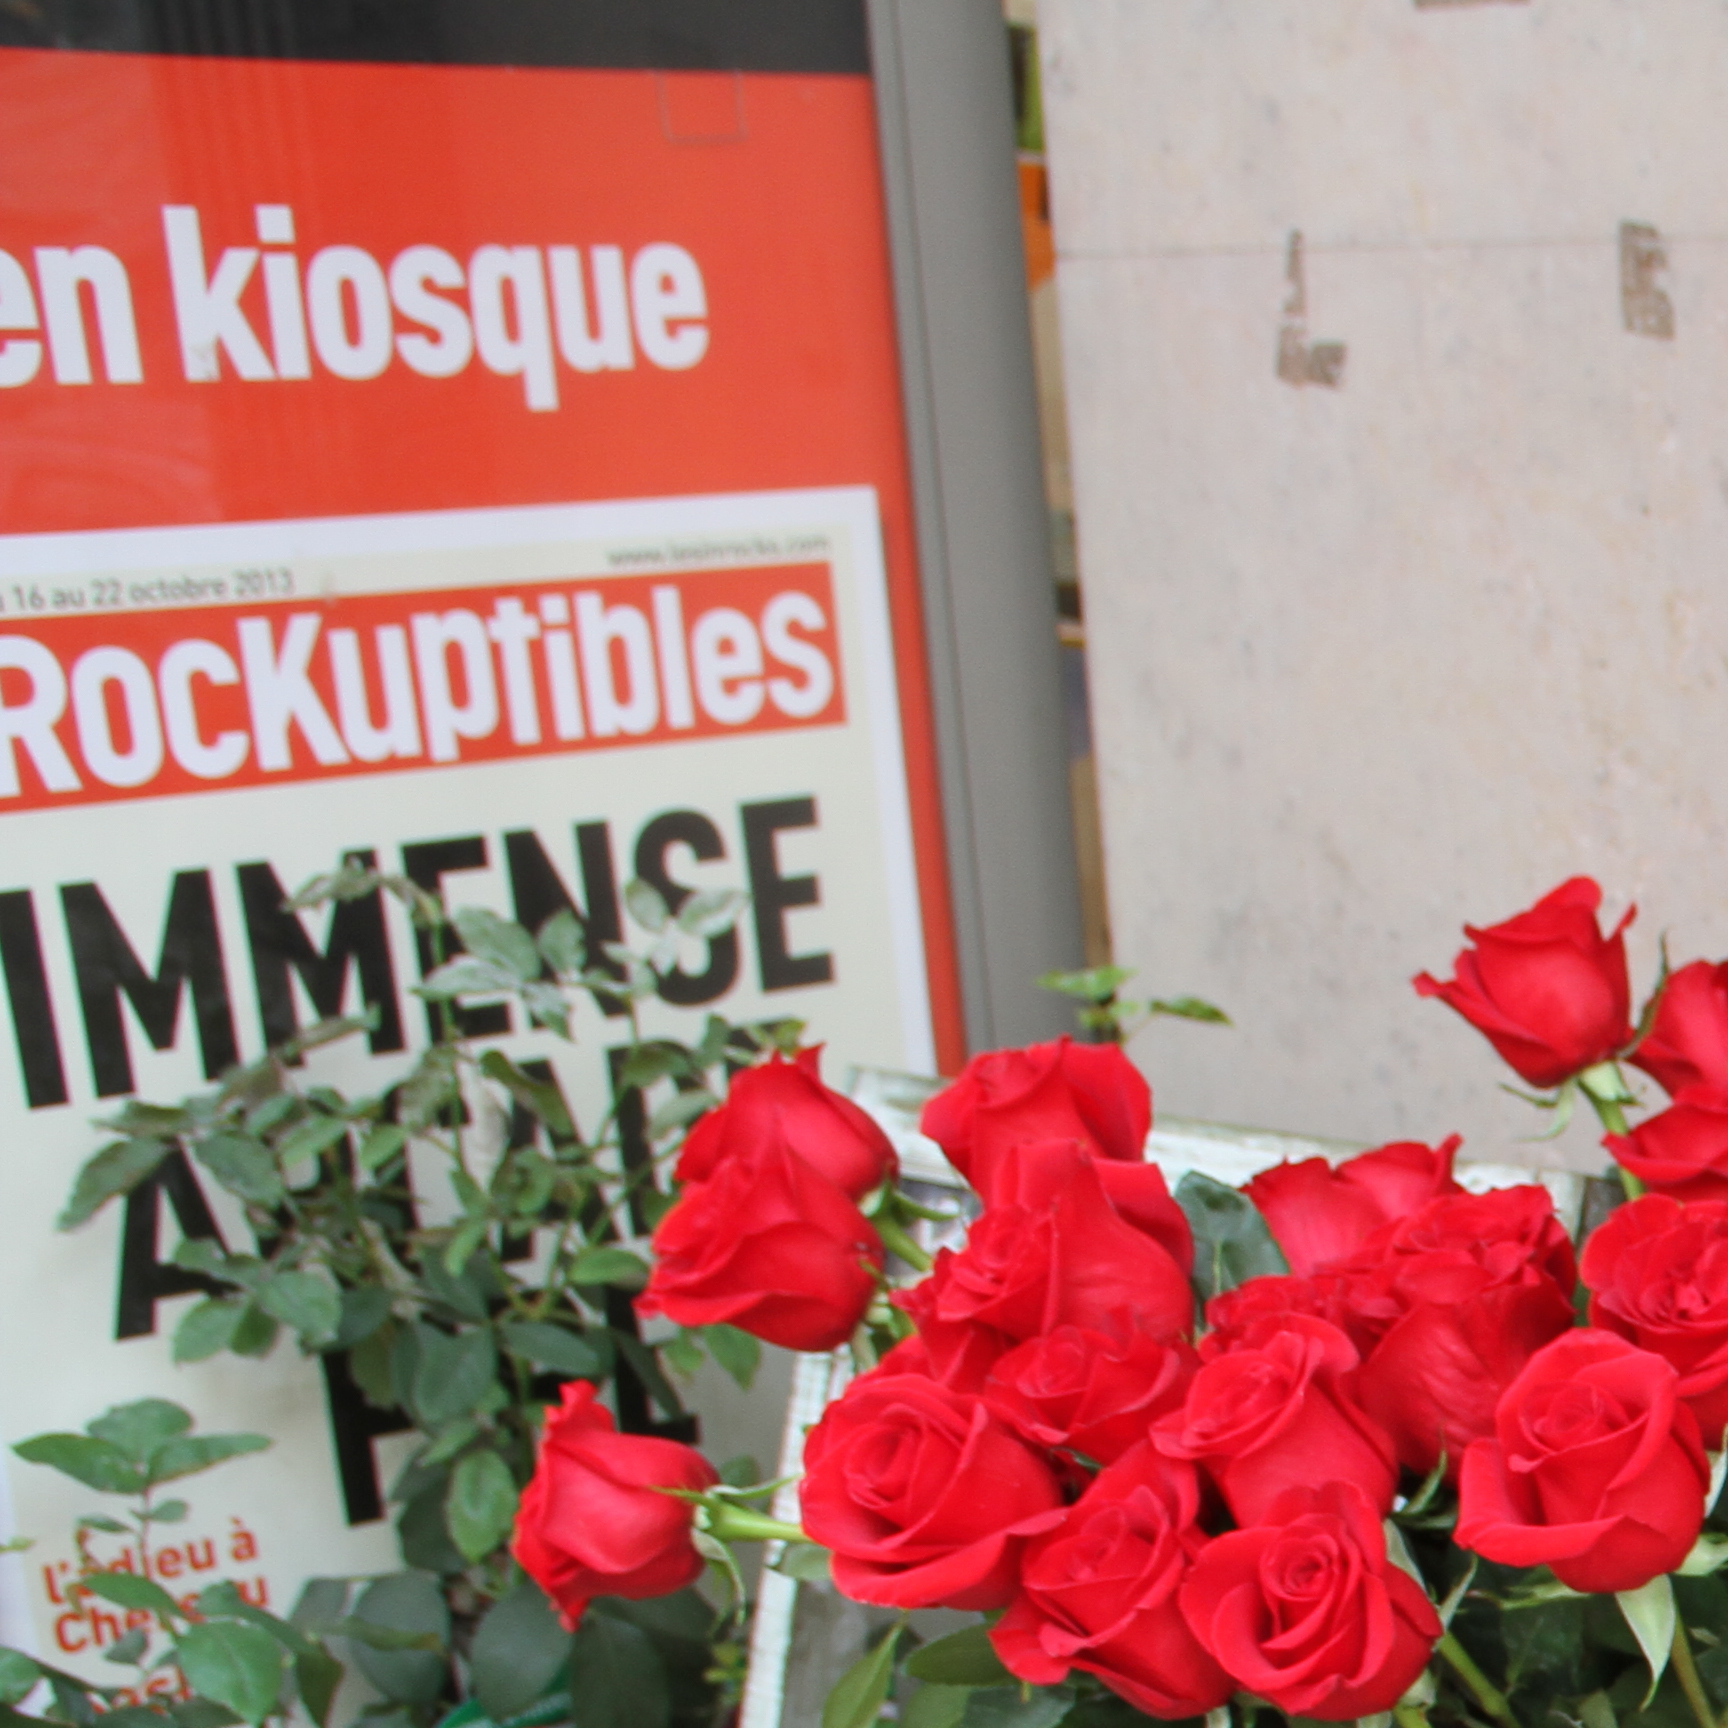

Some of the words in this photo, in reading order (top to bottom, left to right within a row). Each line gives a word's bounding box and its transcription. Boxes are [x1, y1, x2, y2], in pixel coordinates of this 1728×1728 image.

[162, 204, 711, 411] kiosque
[13, 584, 44, 611] 16
[51, 587, 86, 609] au
[91, 577, 123, 606] 22
[129, 571, 227, 601] octobre
[233, 566, 294, 597] 2013
[229, 1515, 258, 1562] à
